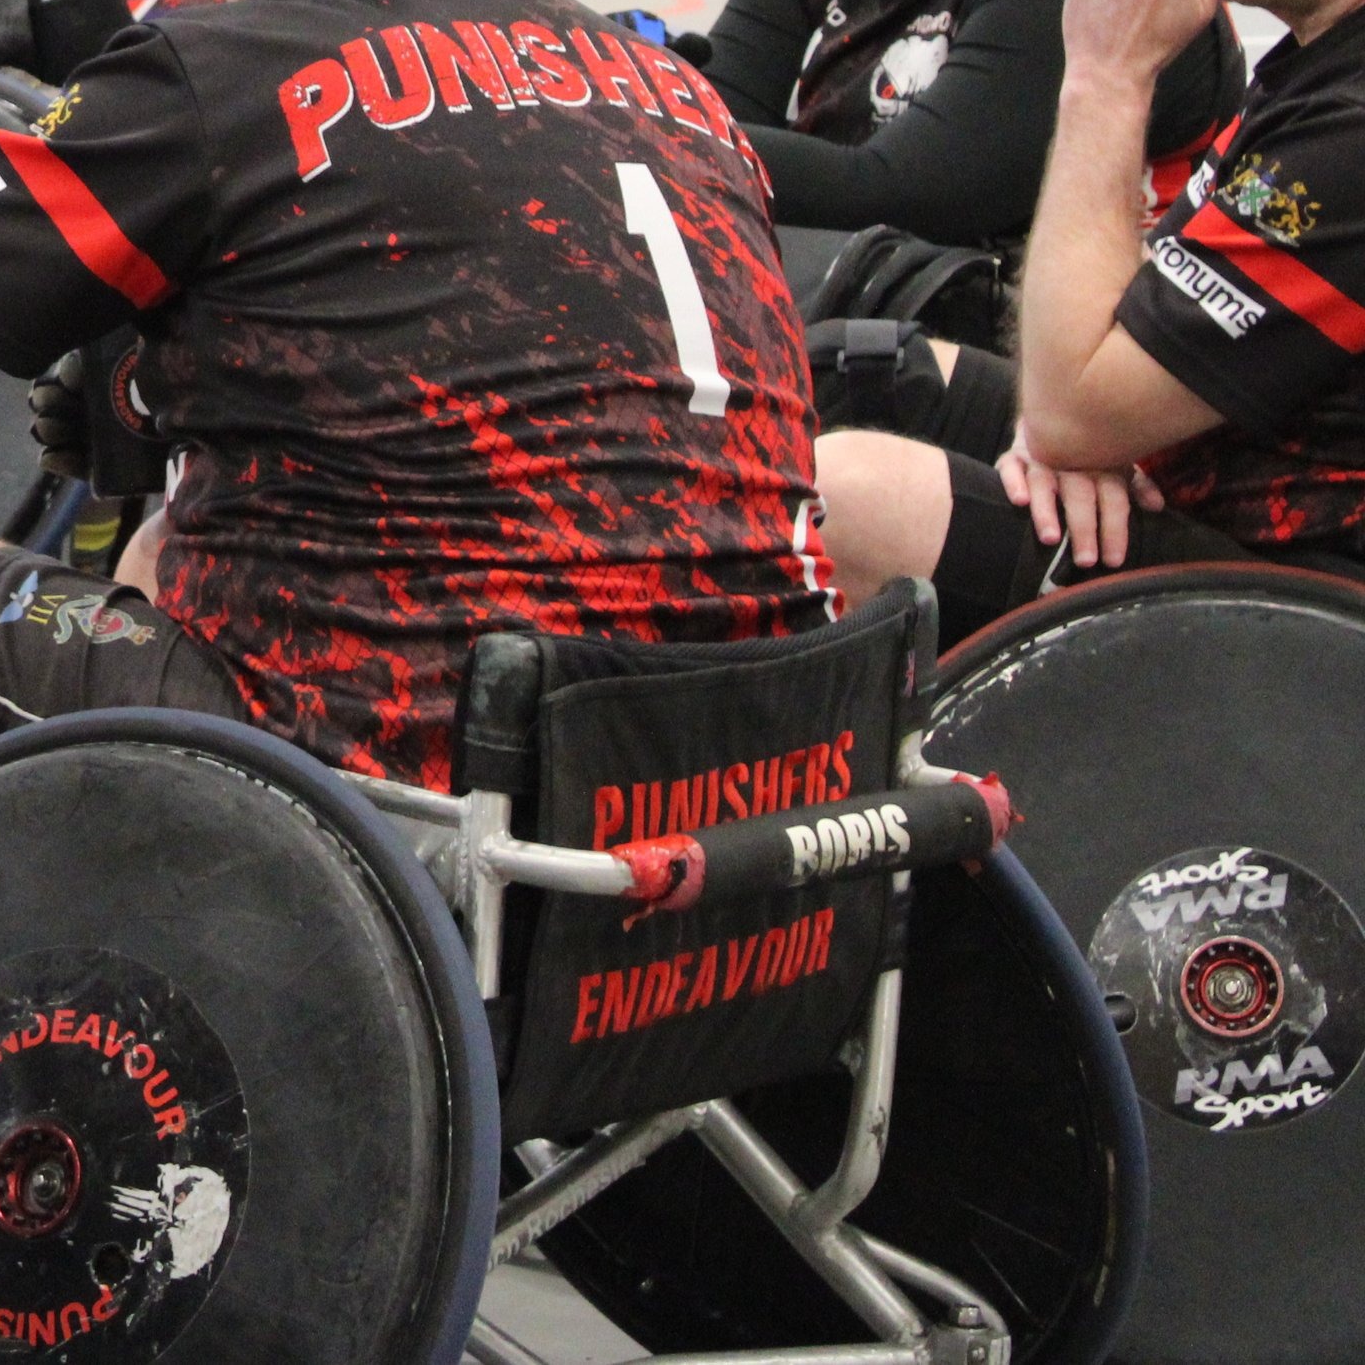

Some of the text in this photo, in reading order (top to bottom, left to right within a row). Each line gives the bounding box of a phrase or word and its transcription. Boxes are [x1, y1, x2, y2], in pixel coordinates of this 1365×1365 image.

[614, 161, 730, 417] 1
[593, 730, 854, 851] PUNISHERS
[1138, 846, 1269, 897] Sport
[1129, 873, 1289, 932] RMA
[570, 907, 834, 1045] ENDEAVOUR
[1174, 1045, 1335, 1104] RMA
[1194, 1081, 1330, 1132] Sport
